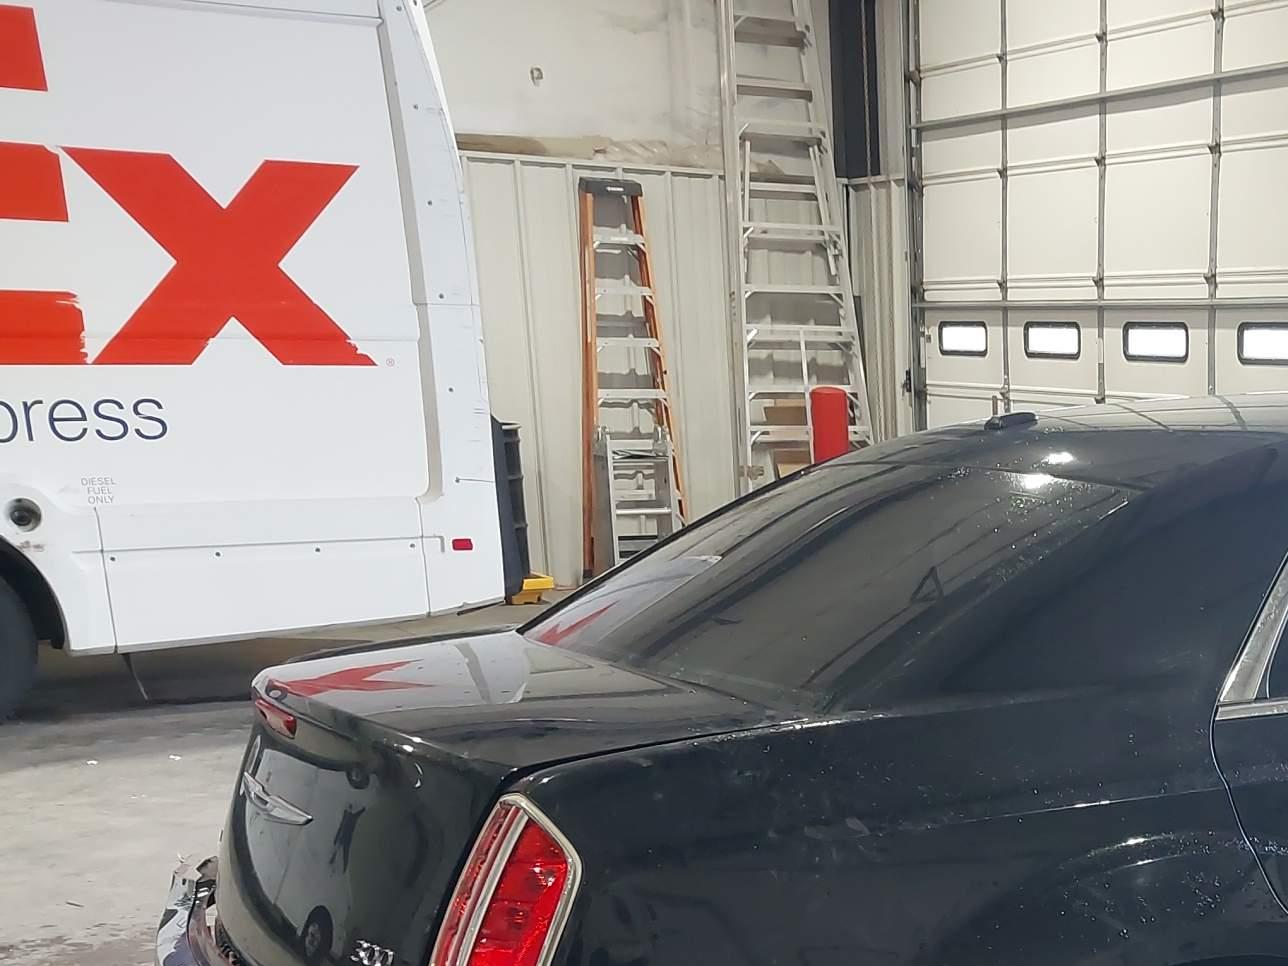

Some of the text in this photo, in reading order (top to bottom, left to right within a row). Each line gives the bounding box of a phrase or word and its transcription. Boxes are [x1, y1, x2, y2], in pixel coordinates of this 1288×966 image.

[80, 477, 117, 486] DIESEL
[87, 486, 112, 495] FUEL
[87, 495, 114, 504] ONLY
